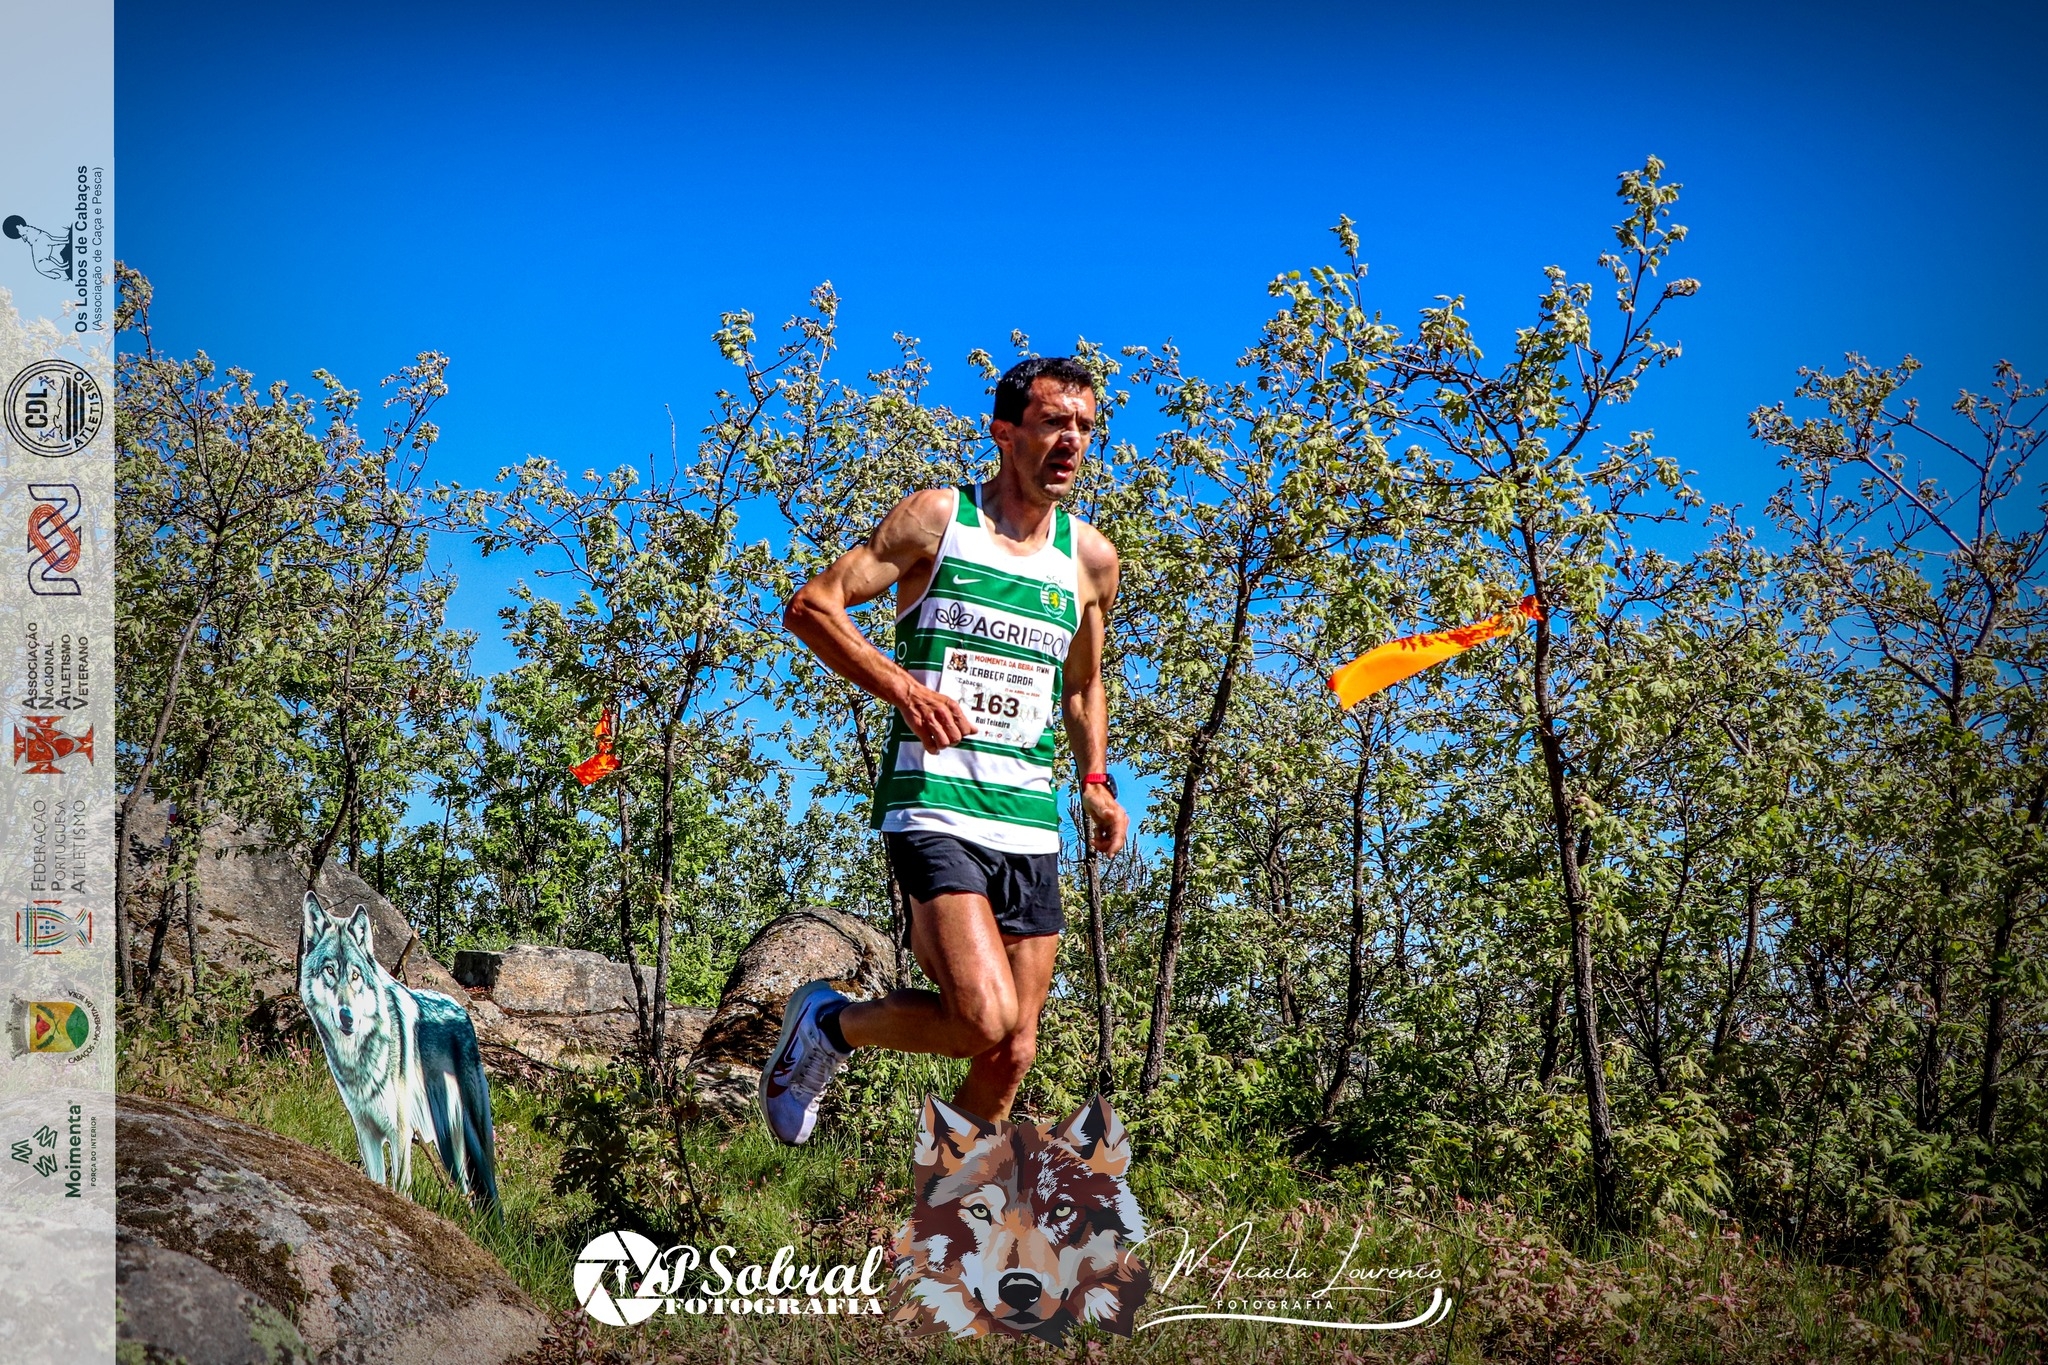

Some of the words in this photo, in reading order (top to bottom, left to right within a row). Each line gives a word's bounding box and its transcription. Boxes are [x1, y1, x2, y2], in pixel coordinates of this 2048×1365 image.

[975, 655, 1007, 667] MOIMENTA
[1009, 660, 1016, 668] DA
[1018, 662, 1034, 671] BEIRA
[971, 667, 1005, 682] CABEÇA
[1007, 674, 1033, 687] GORDA
[971, 692, 1020, 718] 163
[976, 716, 986, 724] Rui
